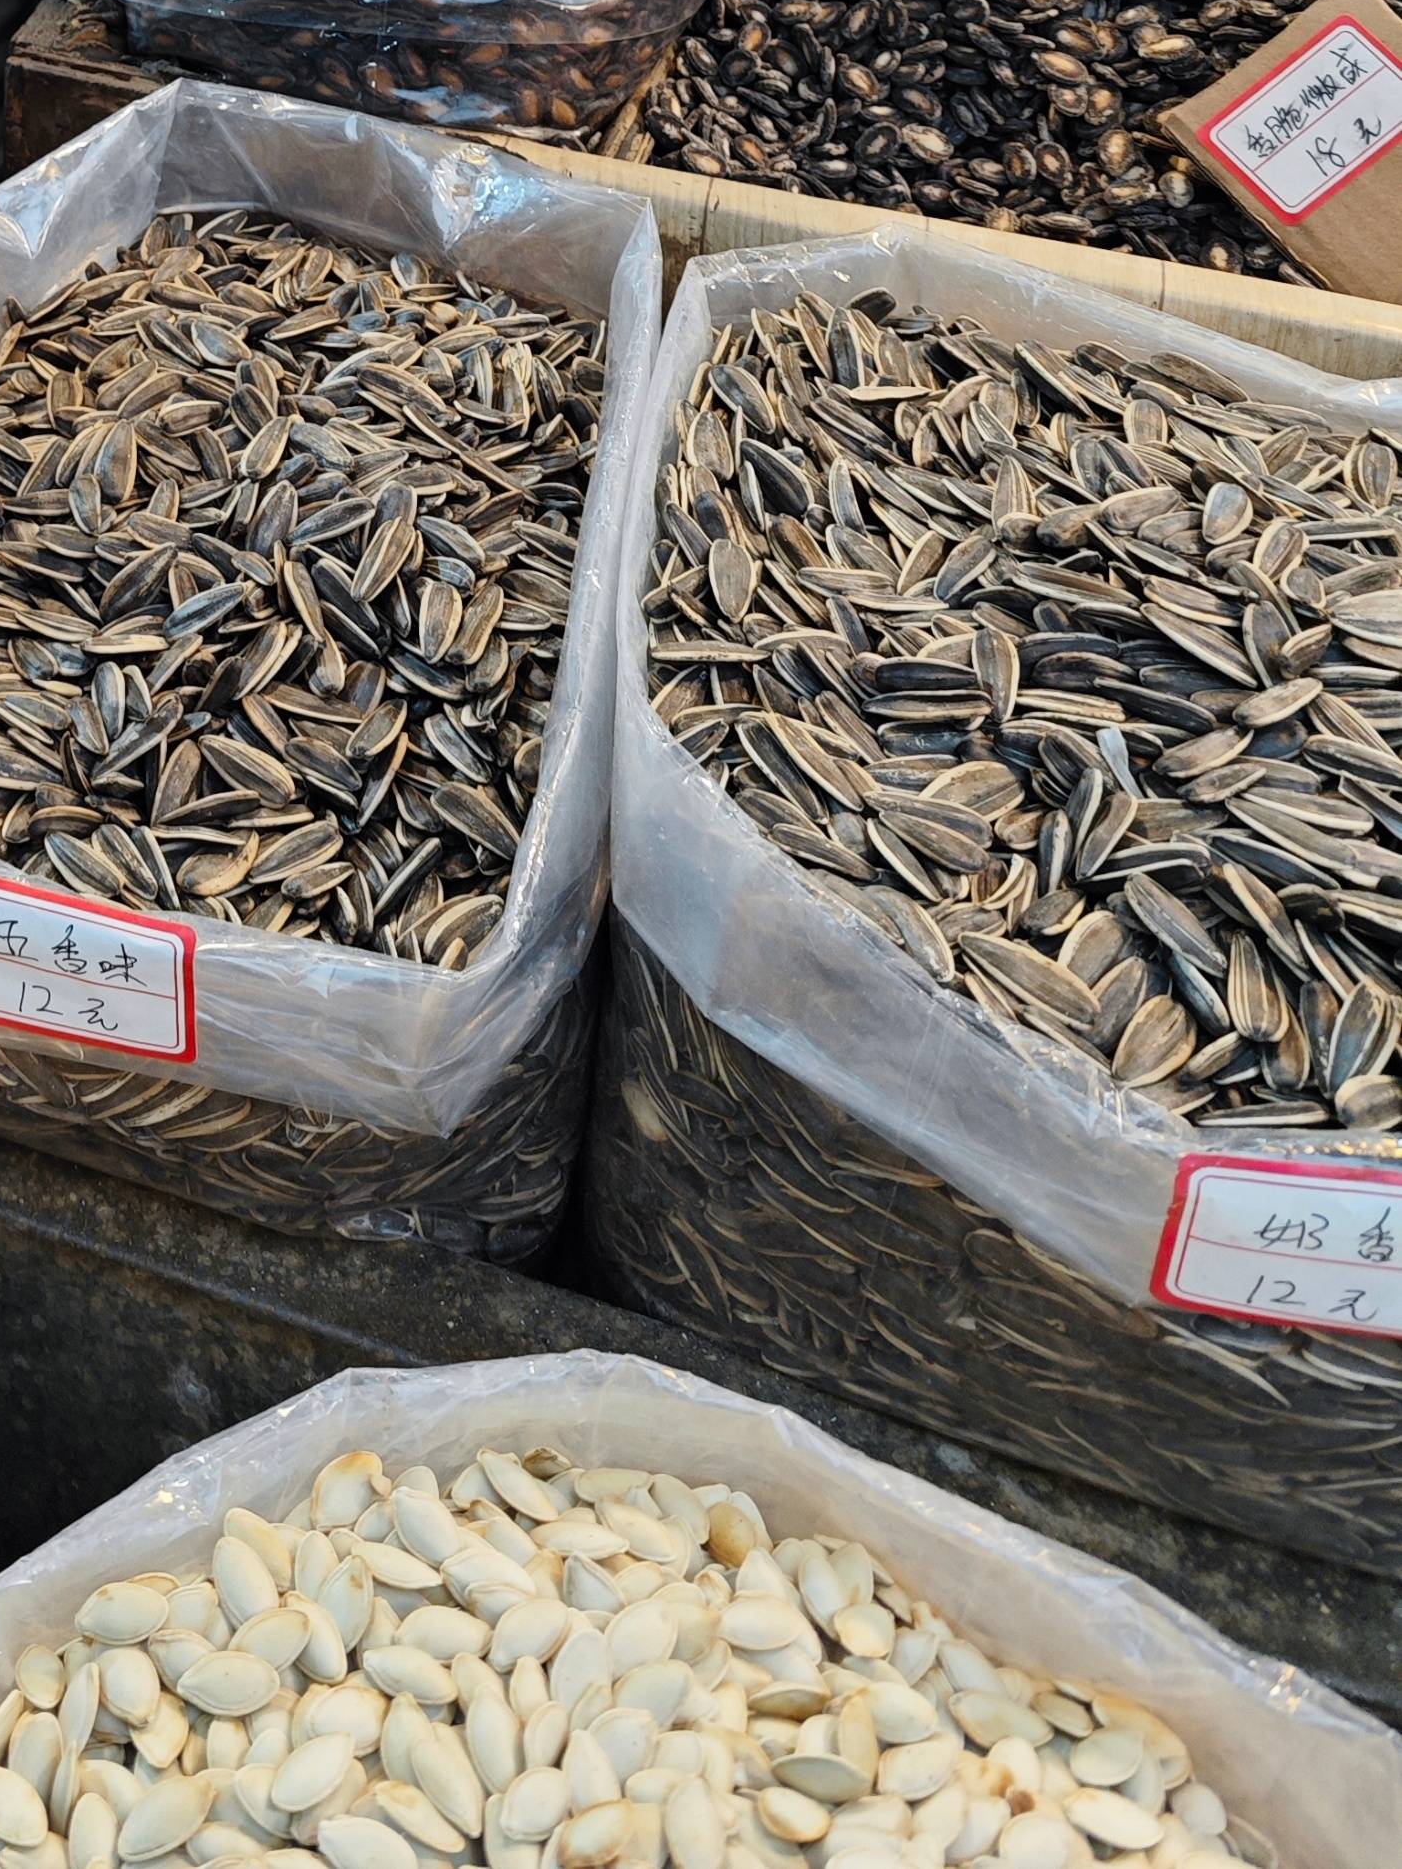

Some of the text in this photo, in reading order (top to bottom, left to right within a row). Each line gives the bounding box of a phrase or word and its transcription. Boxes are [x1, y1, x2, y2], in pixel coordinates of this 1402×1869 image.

[1305, 115, 1383, 178] 18元
[18, 981, 119, 1032] 12元
[1245, 1274, 1379, 1322] 12元
